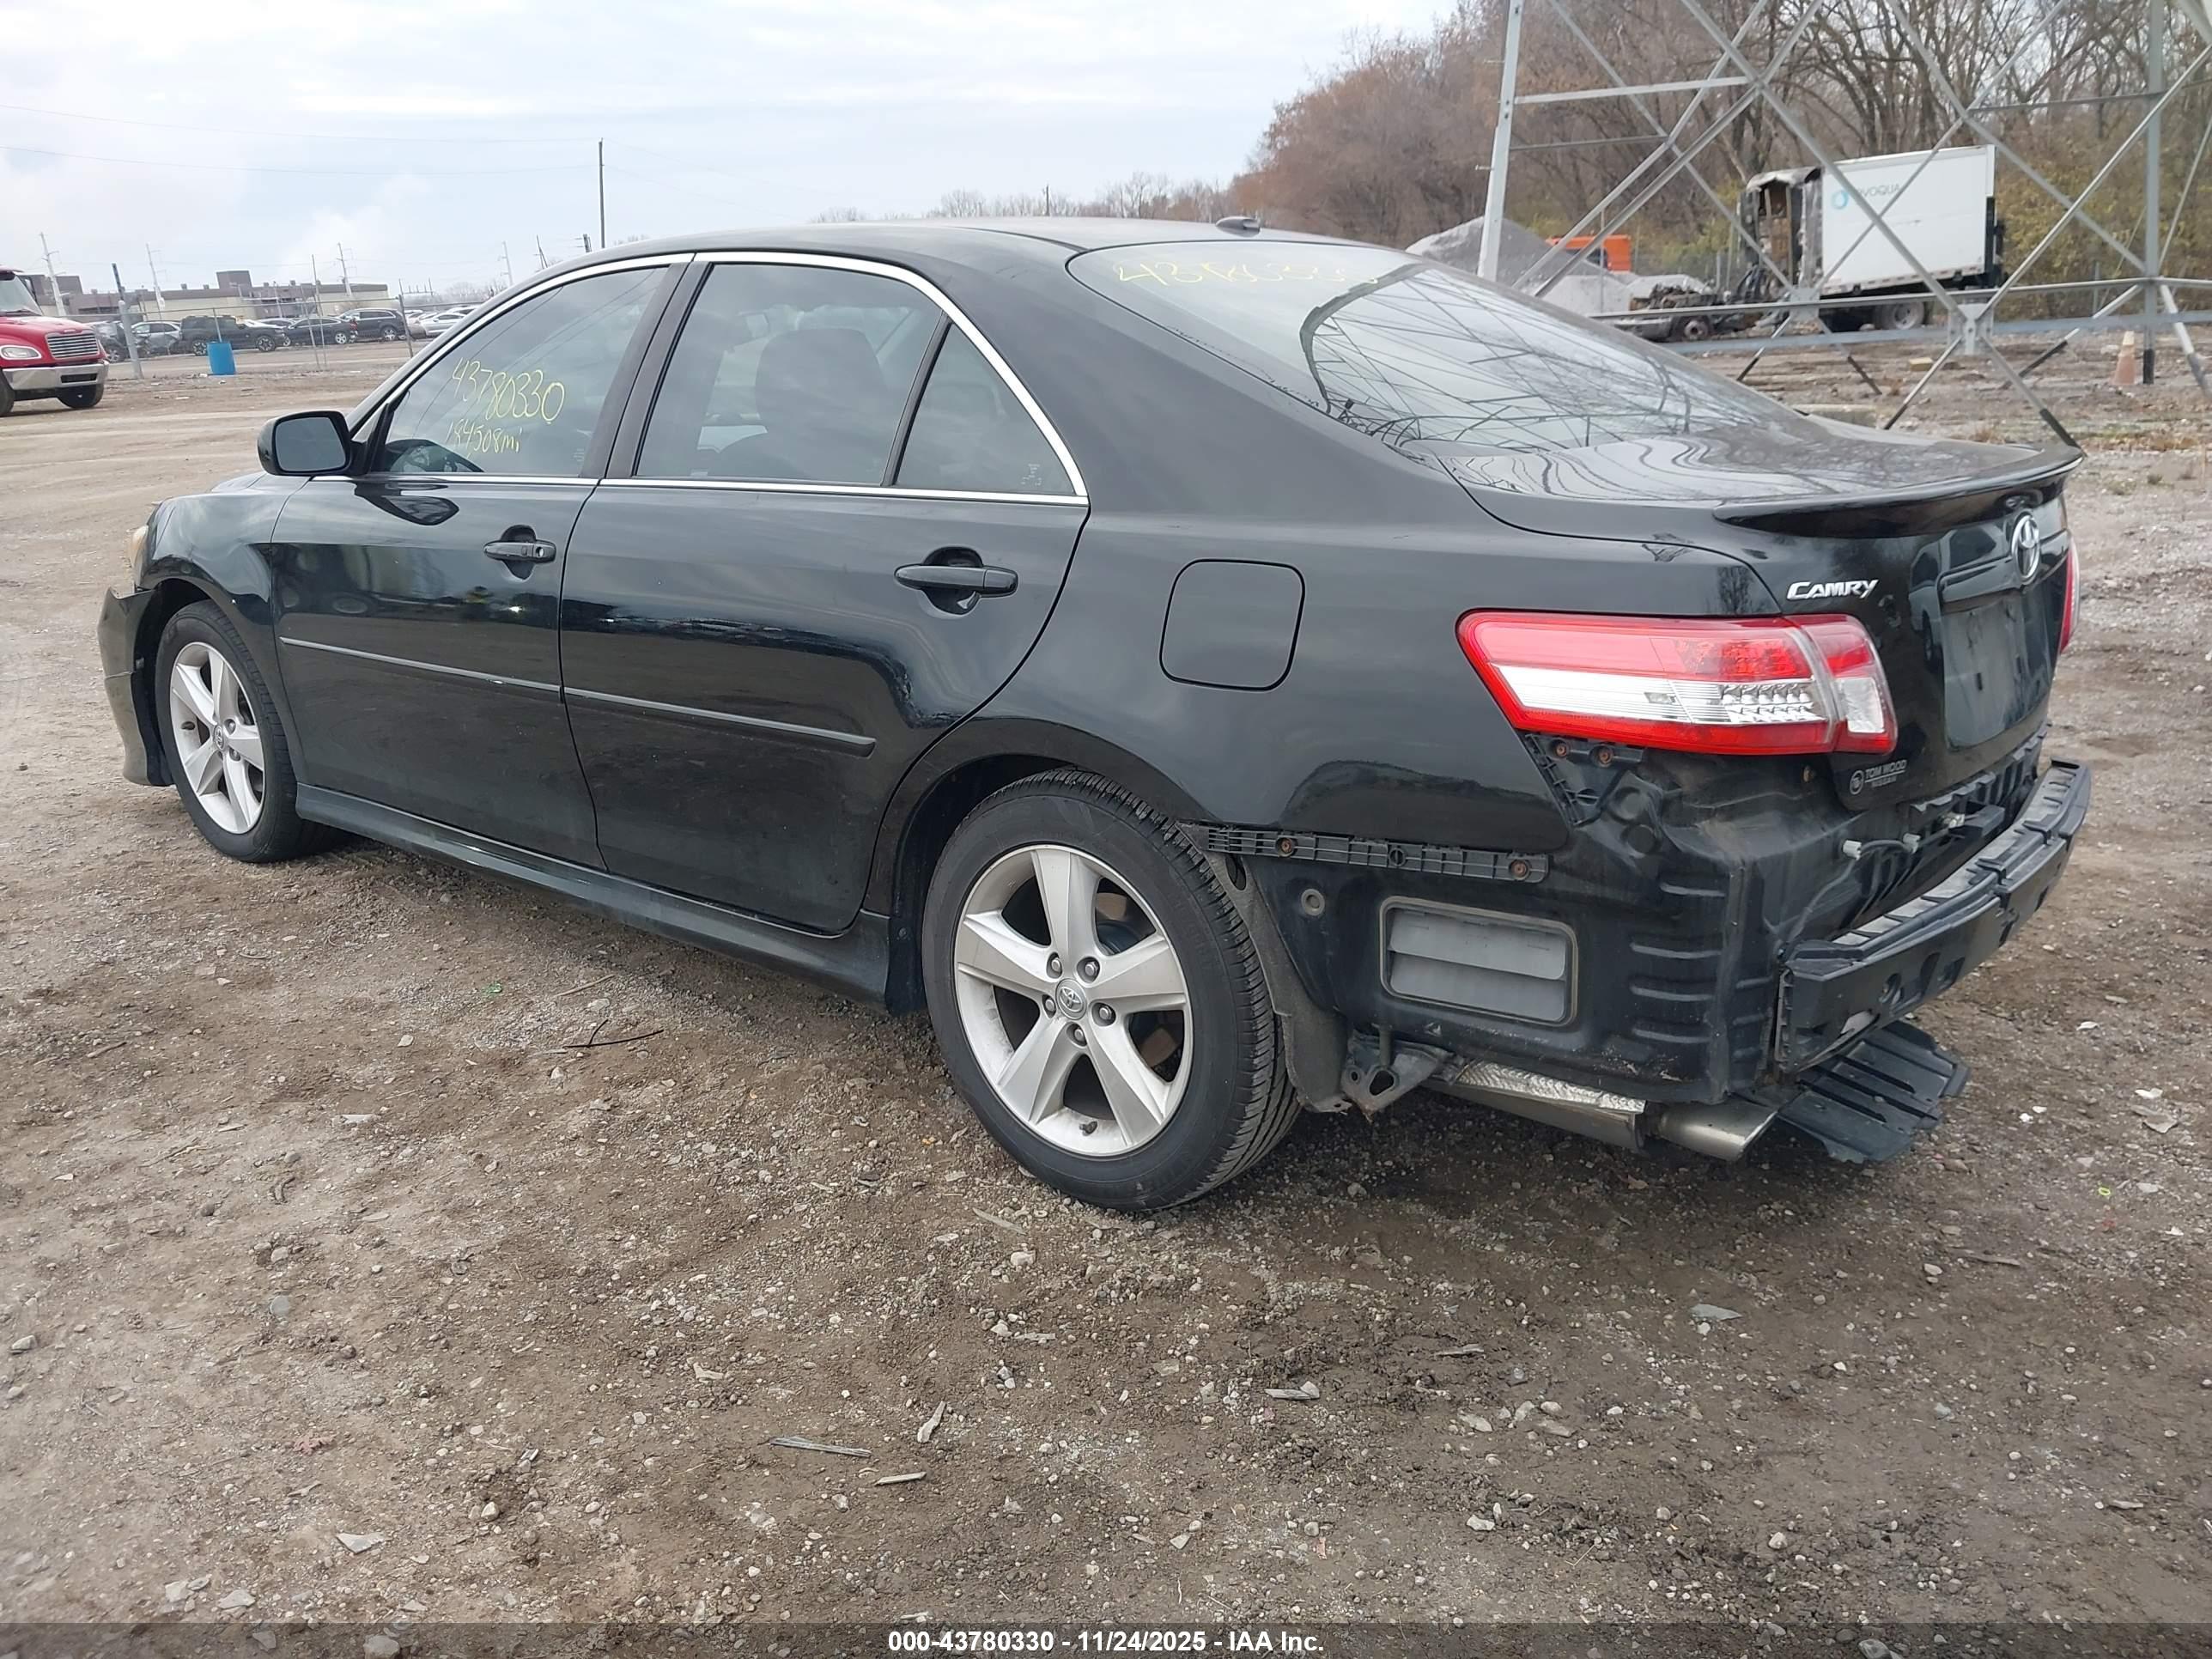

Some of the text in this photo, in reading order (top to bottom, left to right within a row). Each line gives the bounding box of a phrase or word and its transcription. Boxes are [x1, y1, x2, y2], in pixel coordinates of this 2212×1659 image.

[452, 356, 565, 424] 43780330
[1865, 759, 1907, 779] TOM WOOD
